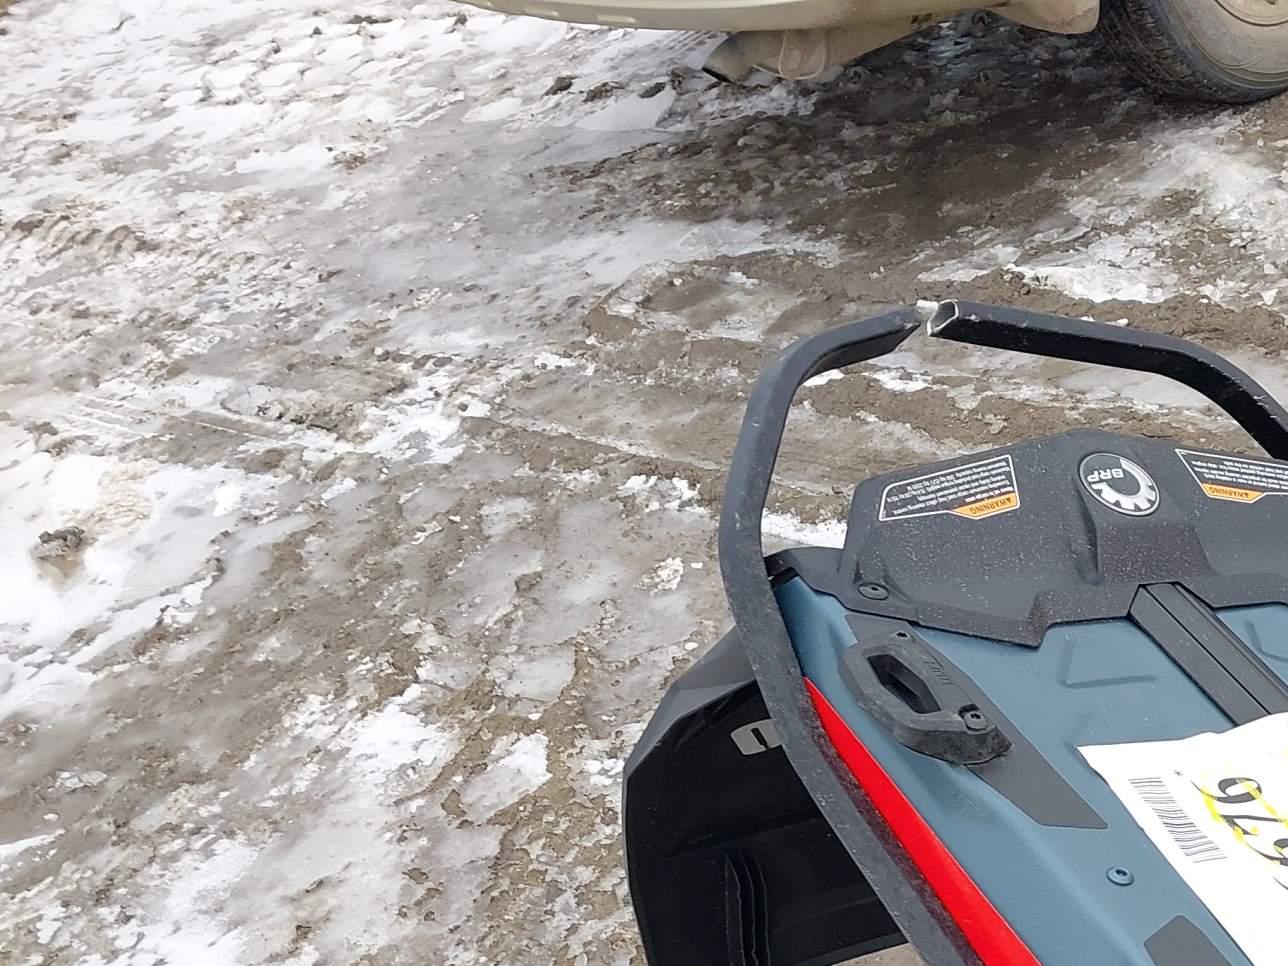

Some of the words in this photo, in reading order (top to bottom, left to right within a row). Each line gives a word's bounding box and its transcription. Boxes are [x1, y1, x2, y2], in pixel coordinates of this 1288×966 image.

[1086, 467, 1124, 482] BRP
[1209, 486, 1245, 499] WARNING
[968, 498, 1007, 515] WARNING
